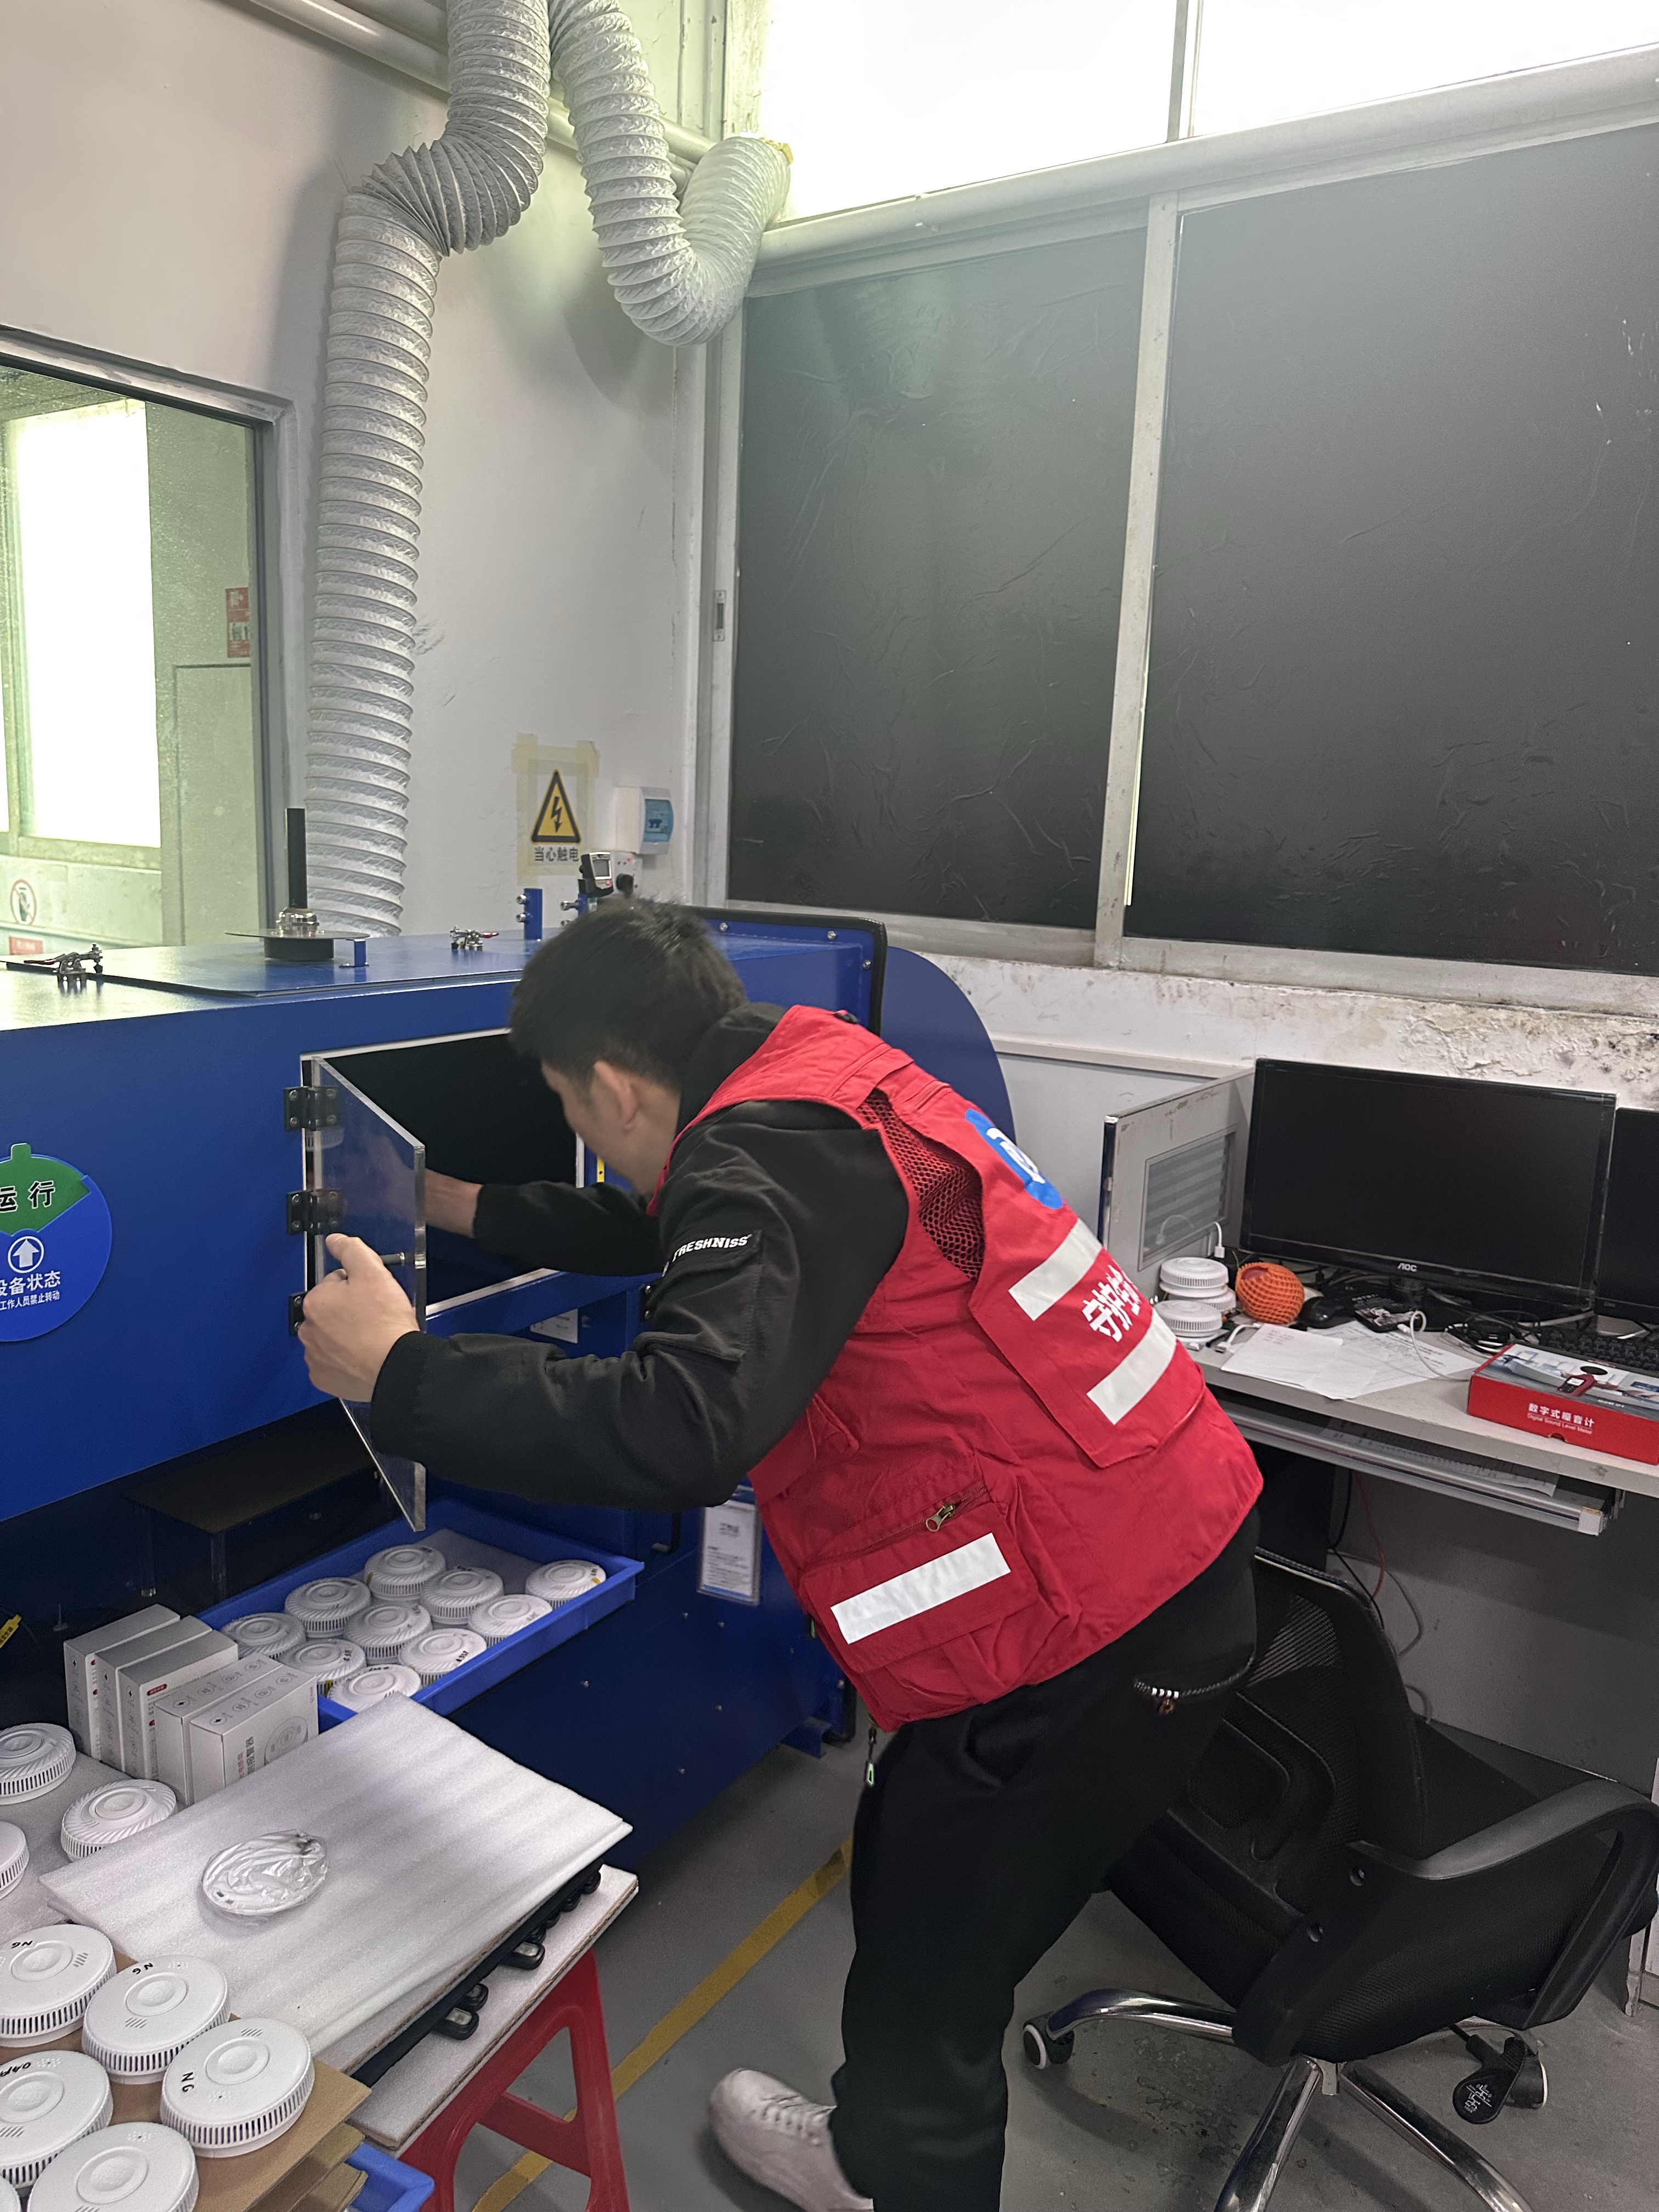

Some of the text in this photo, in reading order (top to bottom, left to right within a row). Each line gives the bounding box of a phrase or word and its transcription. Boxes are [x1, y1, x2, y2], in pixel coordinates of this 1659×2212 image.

[534, 846, 579, 862] 当心触电
[0, 1180, 55, 1213] 运行
[1398, 1262, 1417, 1272] AOC
[0, 1290, 60, 1311] 工作人员禁止转动
[11, 1940, 33, 1949] NG
[132, 1962, 154, 1974] NG
[181, 2072, 195, 2092] NG
